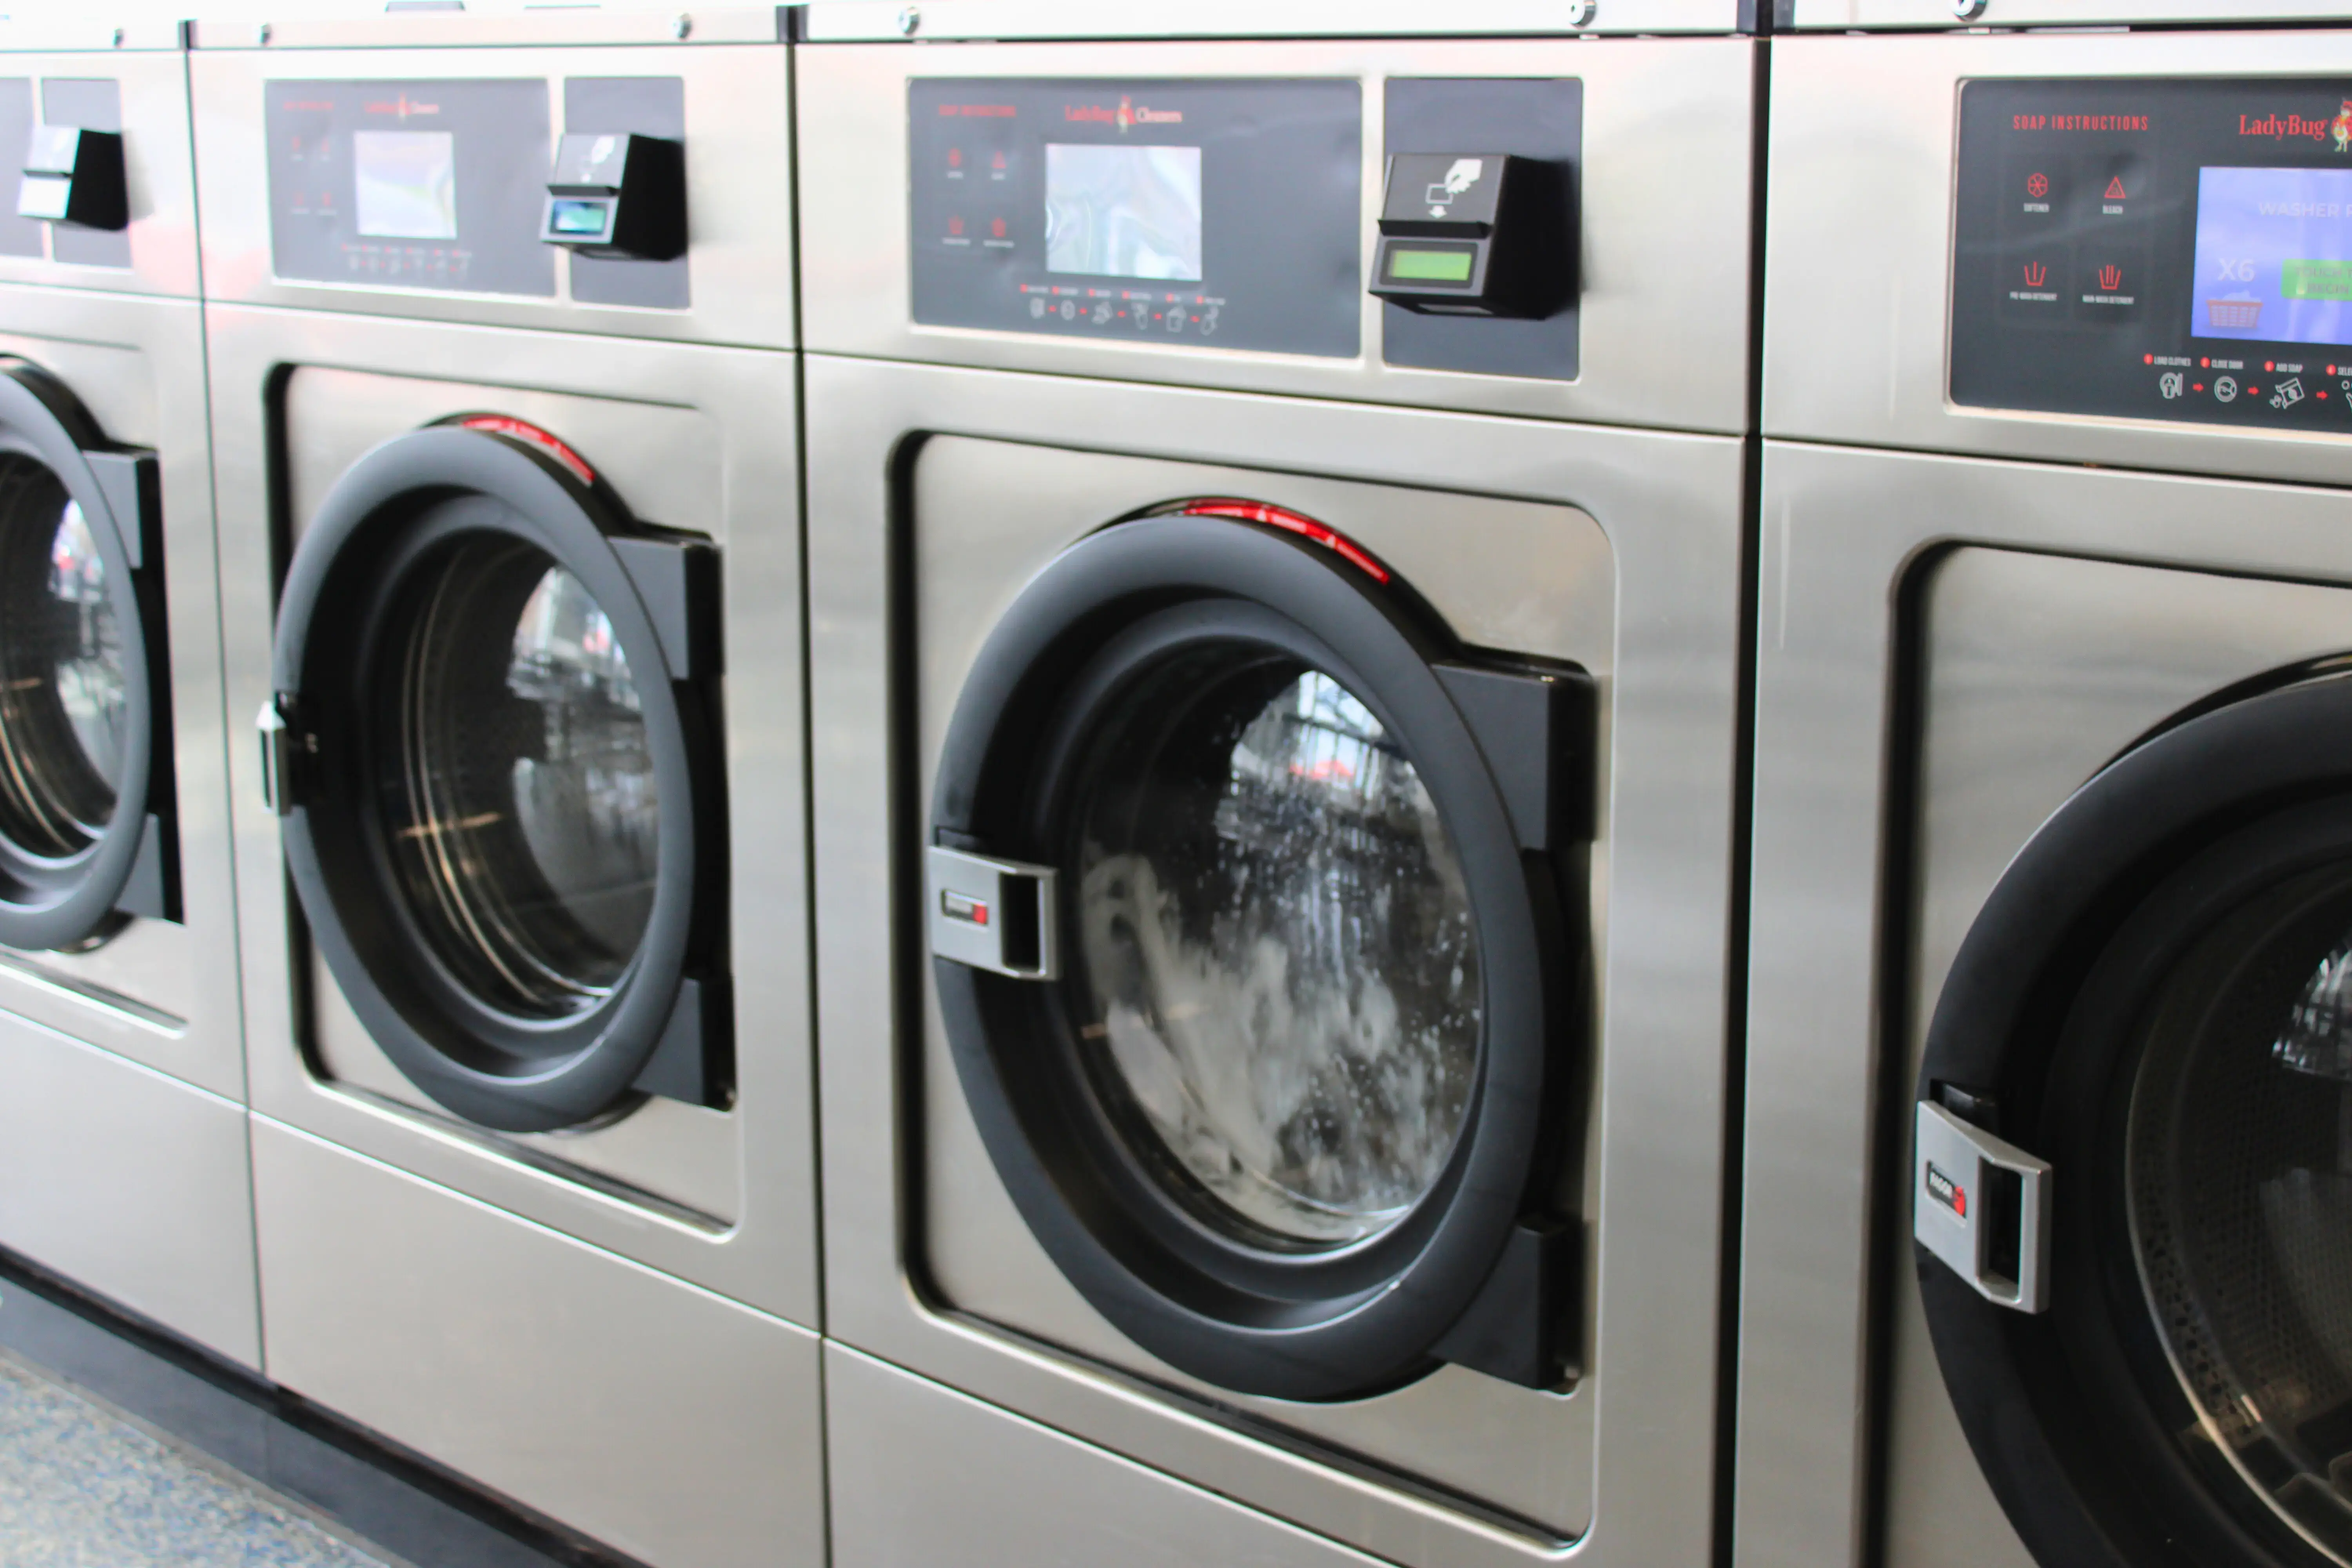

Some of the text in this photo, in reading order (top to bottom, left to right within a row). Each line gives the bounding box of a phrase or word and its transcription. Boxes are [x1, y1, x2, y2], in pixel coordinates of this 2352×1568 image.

[2013, 114, 2149, 131] SOAP INSTRUCTIONS
[2239, 113, 2328, 141] LadyBug
[2258, 201, 2340, 218] WASHER
[2218, 257, 2256, 282] X6
